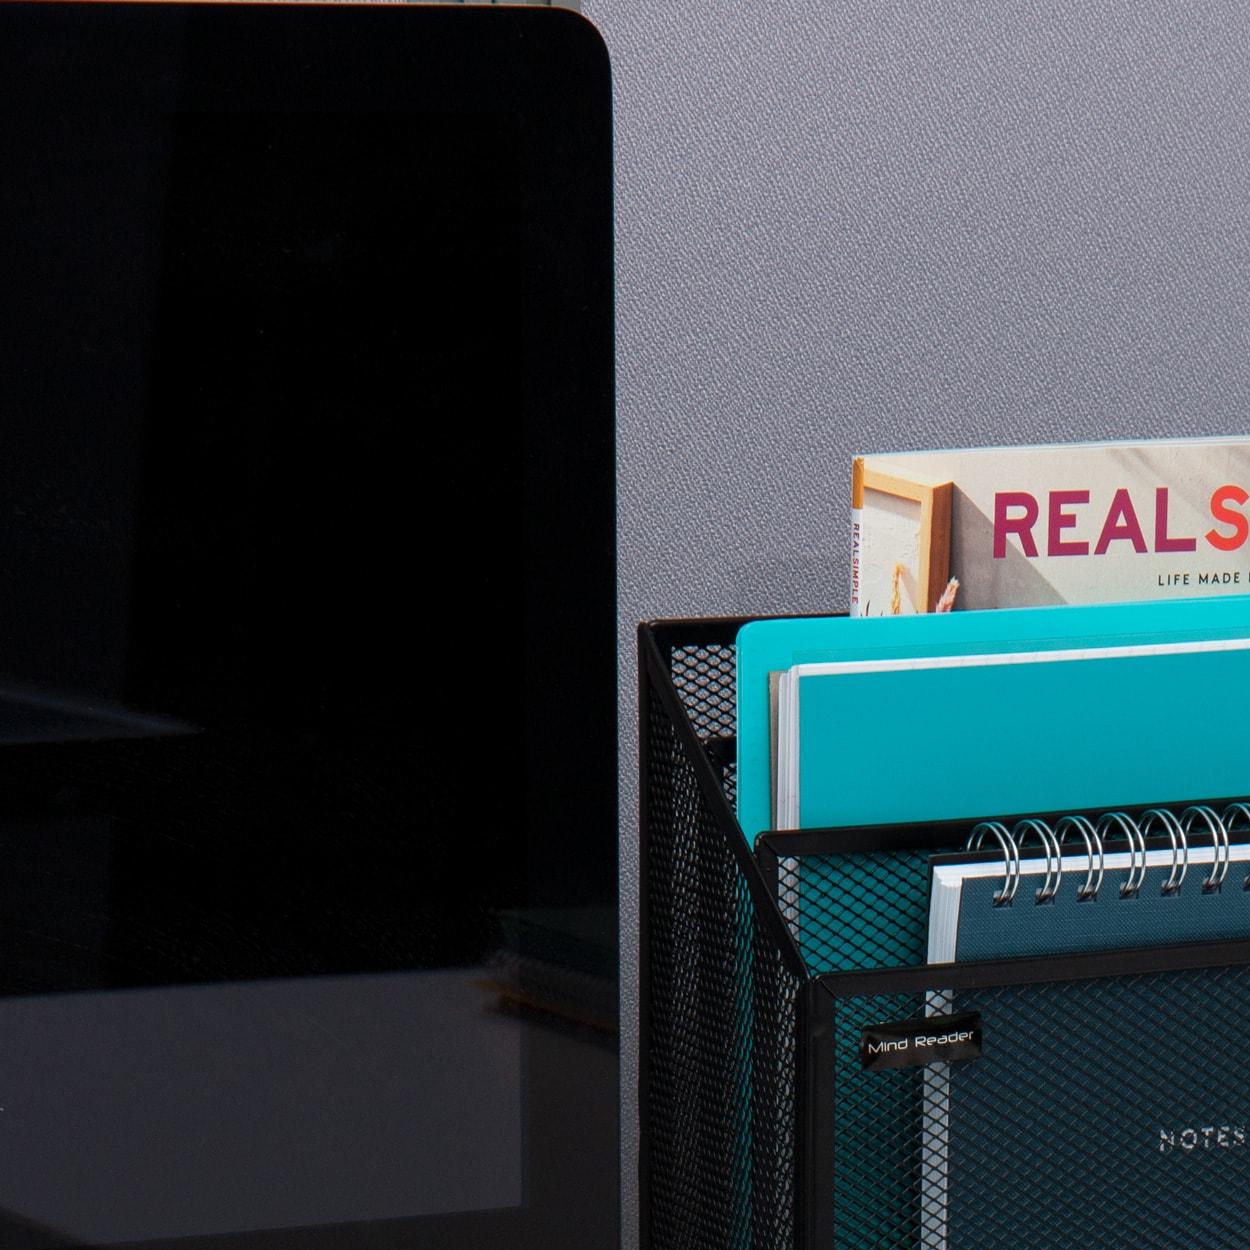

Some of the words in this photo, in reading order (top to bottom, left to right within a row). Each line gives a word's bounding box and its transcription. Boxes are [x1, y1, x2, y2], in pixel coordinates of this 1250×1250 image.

[993, 486, 1197, 559] REAL
[1158, 573, 1190, 586] LIFE
[1198, 571, 1241, 585] MADE
[867, 1038, 909, 1054] Mind
[914, 1030, 974, 1048] Reader
[1159, 1125, 1246, 1152] NOTES
